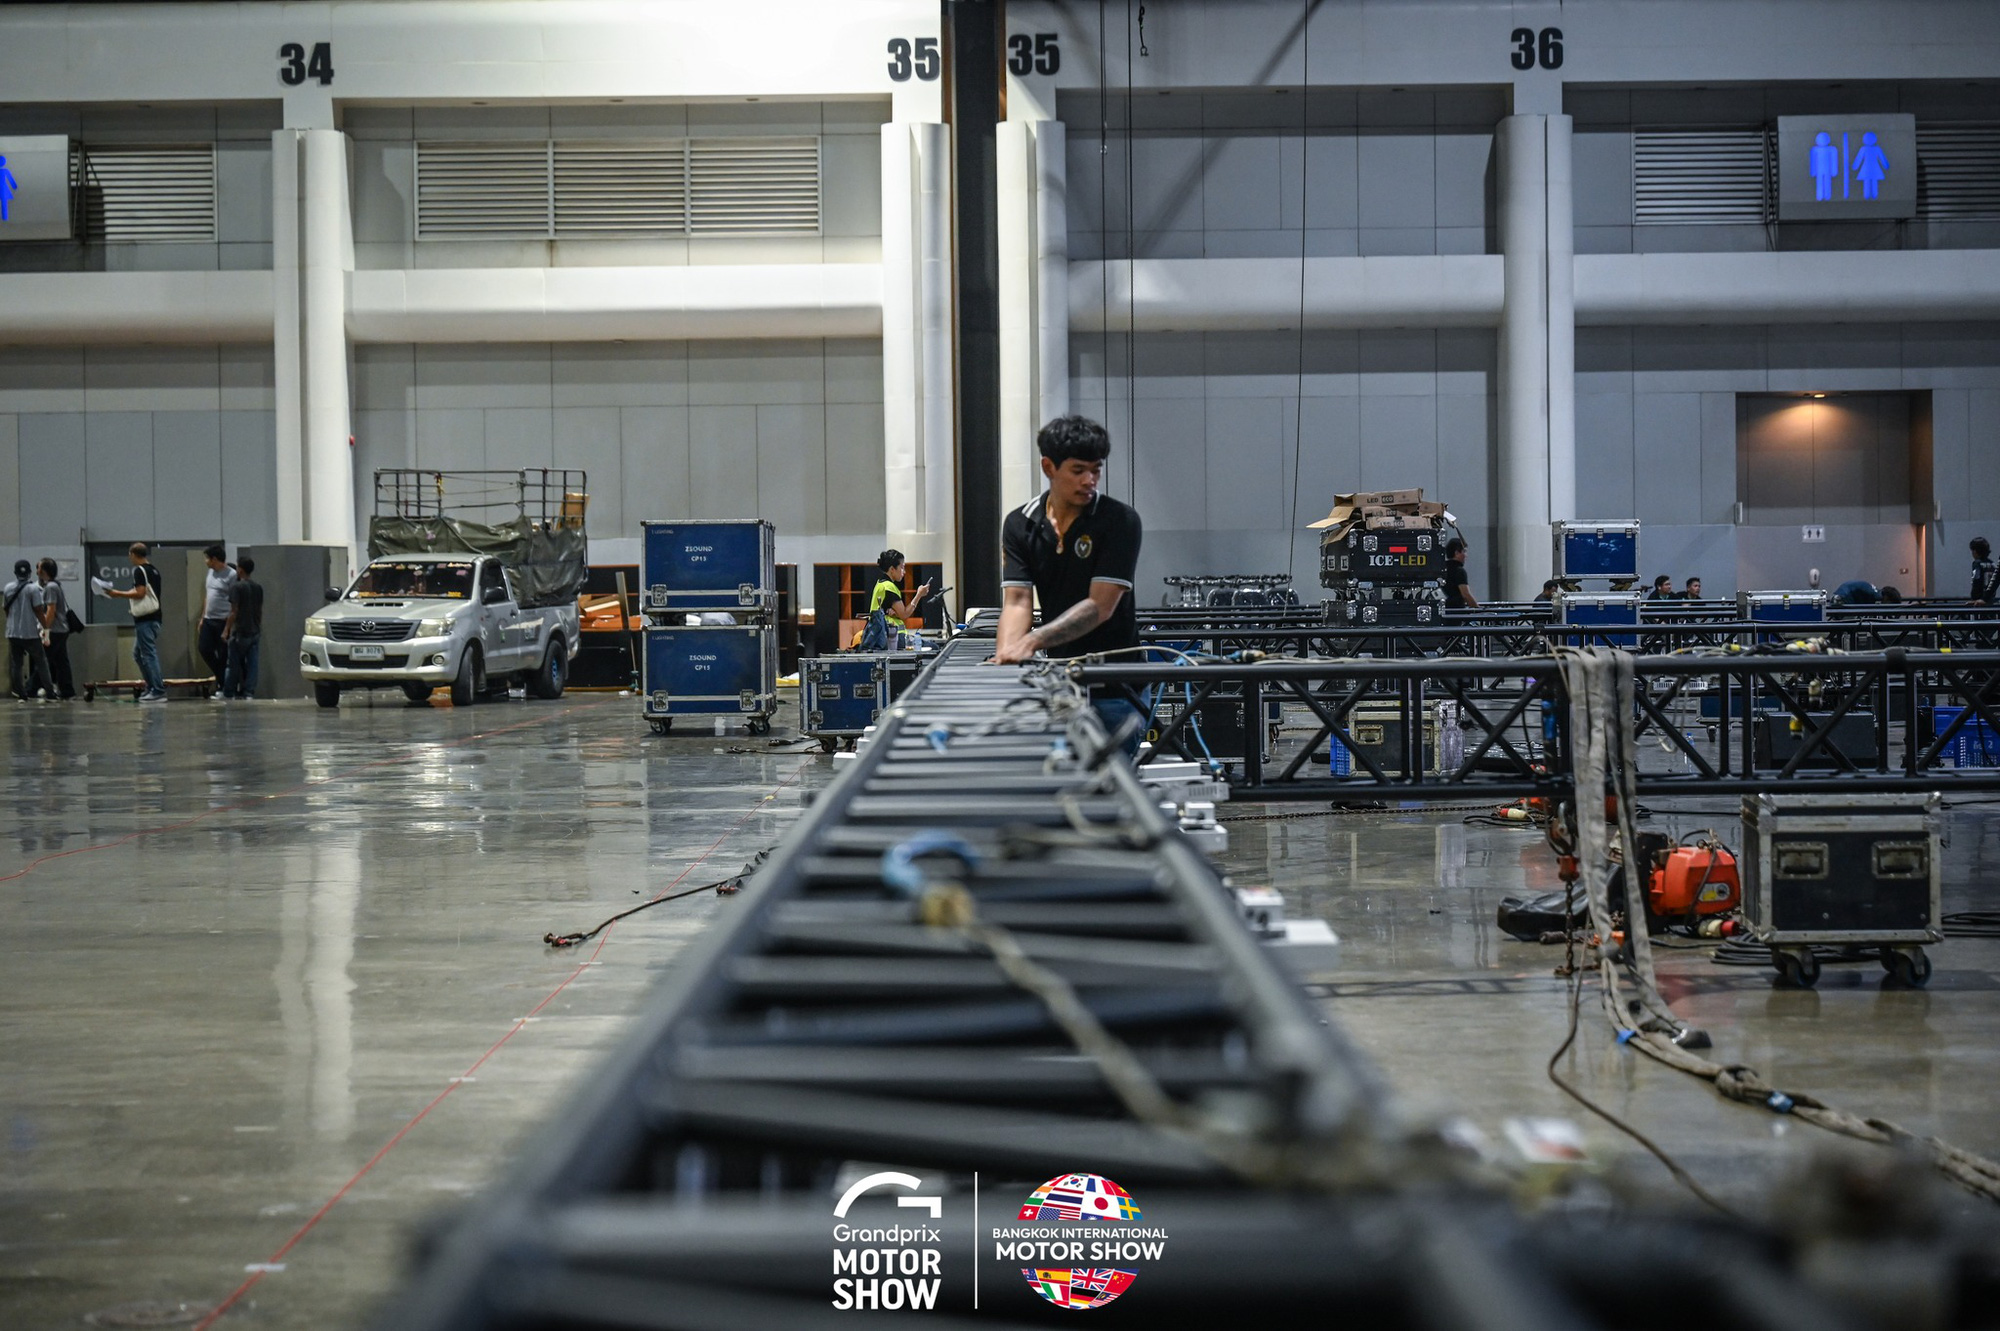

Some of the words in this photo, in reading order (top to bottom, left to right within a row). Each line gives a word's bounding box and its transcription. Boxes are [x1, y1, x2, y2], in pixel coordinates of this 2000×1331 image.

[1008, 33, 1061, 77] 35
[1510, 28, 1564, 70] 36
[280, 42, 335, 87] 34
[888, 37, 941, 82] 35
[1382, 495, 1393, 503] ECO
[685, 545, 713, 553] ZSOUND
[1369, 554, 1427, 567] ICE-LED
[100, 566, 137, 579] C10
[688, 654, 717, 662] ZSOUND
